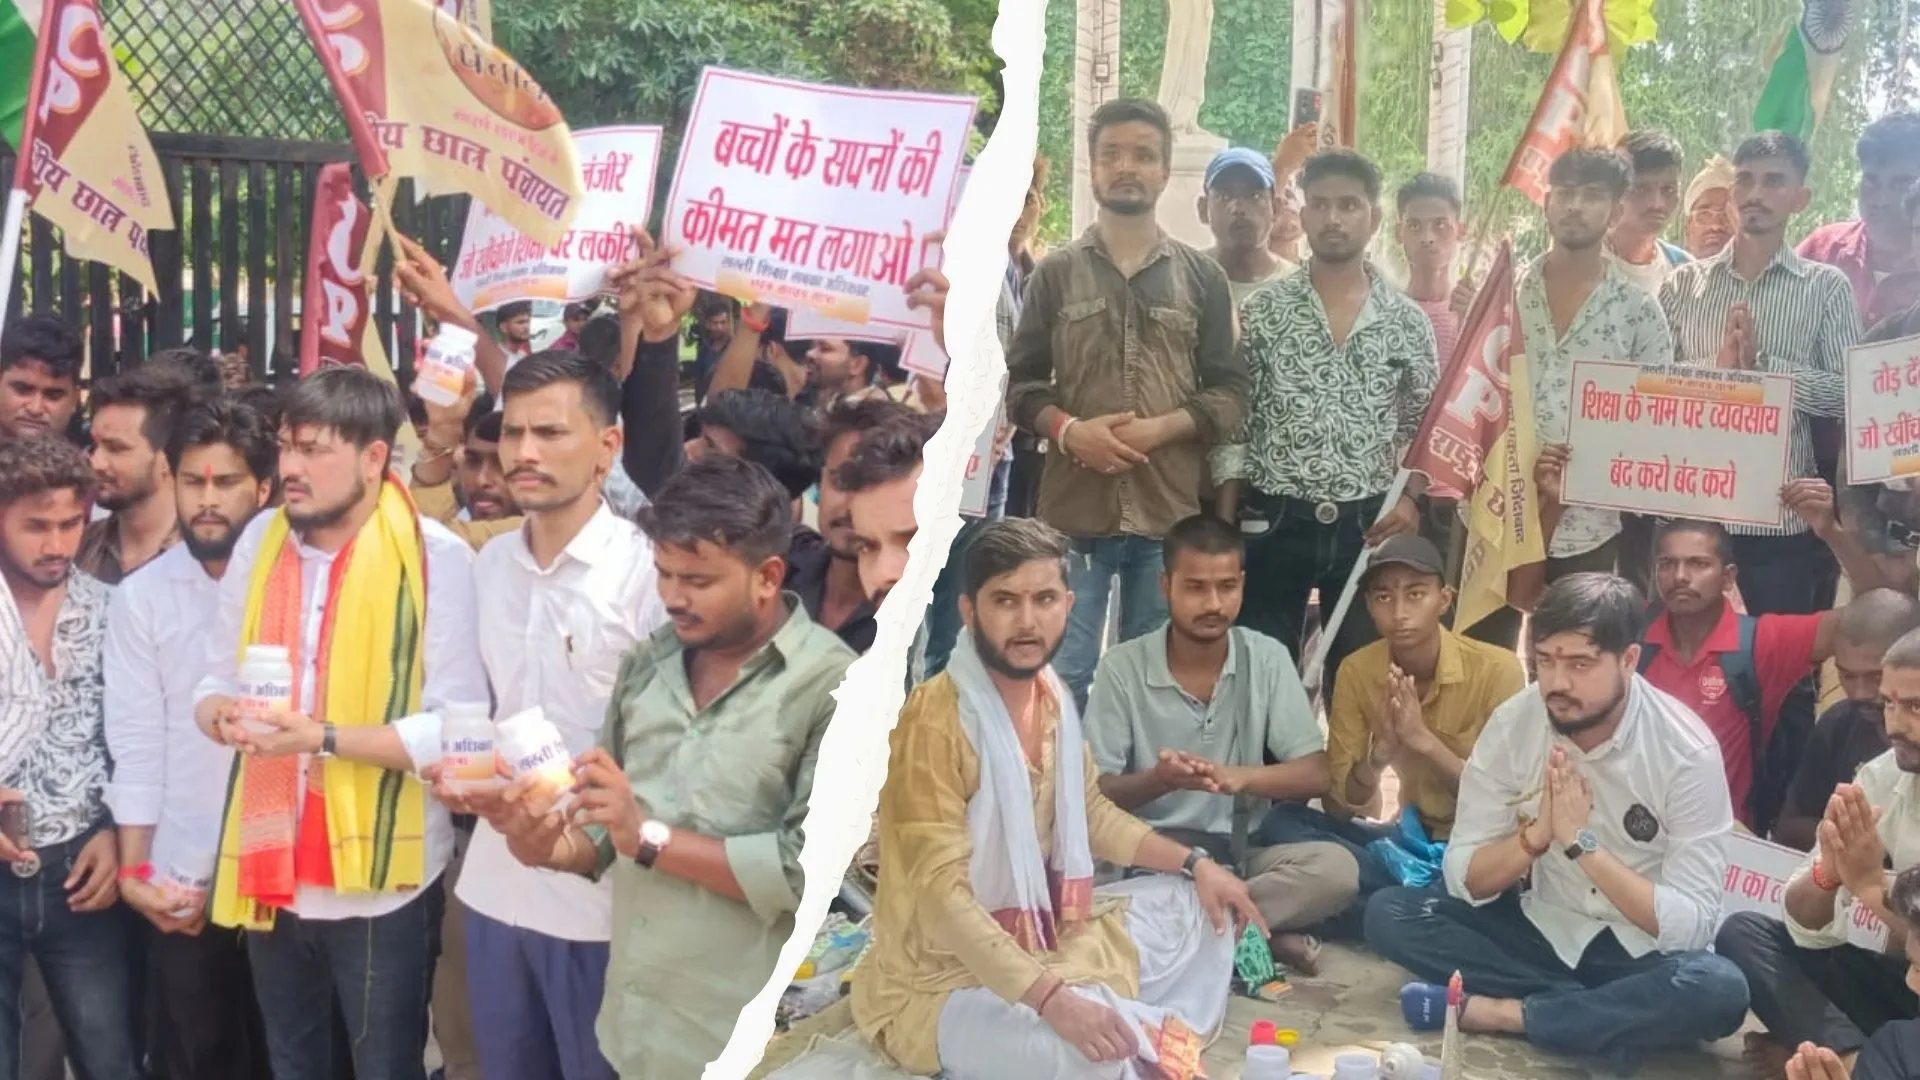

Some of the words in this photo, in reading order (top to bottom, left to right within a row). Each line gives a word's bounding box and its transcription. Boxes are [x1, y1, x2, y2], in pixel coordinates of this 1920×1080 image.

[420, 124, 491, 173] छात्र
[501, 156, 570, 220] पंचायत
[713, 113, 790, 176] बच्चों
[784, 118, 823, 180] के
[822, 128, 905, 192] सपनों
[897, 129, 942, 197] की
[681, 186, 769, 254] कीमत
[769, 215, 819, 268] मत
[817, 219, 915, 287] लगाओ
[1581, 379, 1622, 423] शिक्षा
[1624, 384, 1644, 423] के
[1646, 395, 1679, 427] नाम
[1682, 399, 1707, 430] पर
[1708, 401, 1781, 436] व्यवसाय
[1857, 416, 1879, 450] जो
[1610, 450, 1634, 491] बंद
[1637, 453, 1671, 493] करो
[1673, 456, 1699, 498] बंद
[1701, 459, 1737, 500] करो
